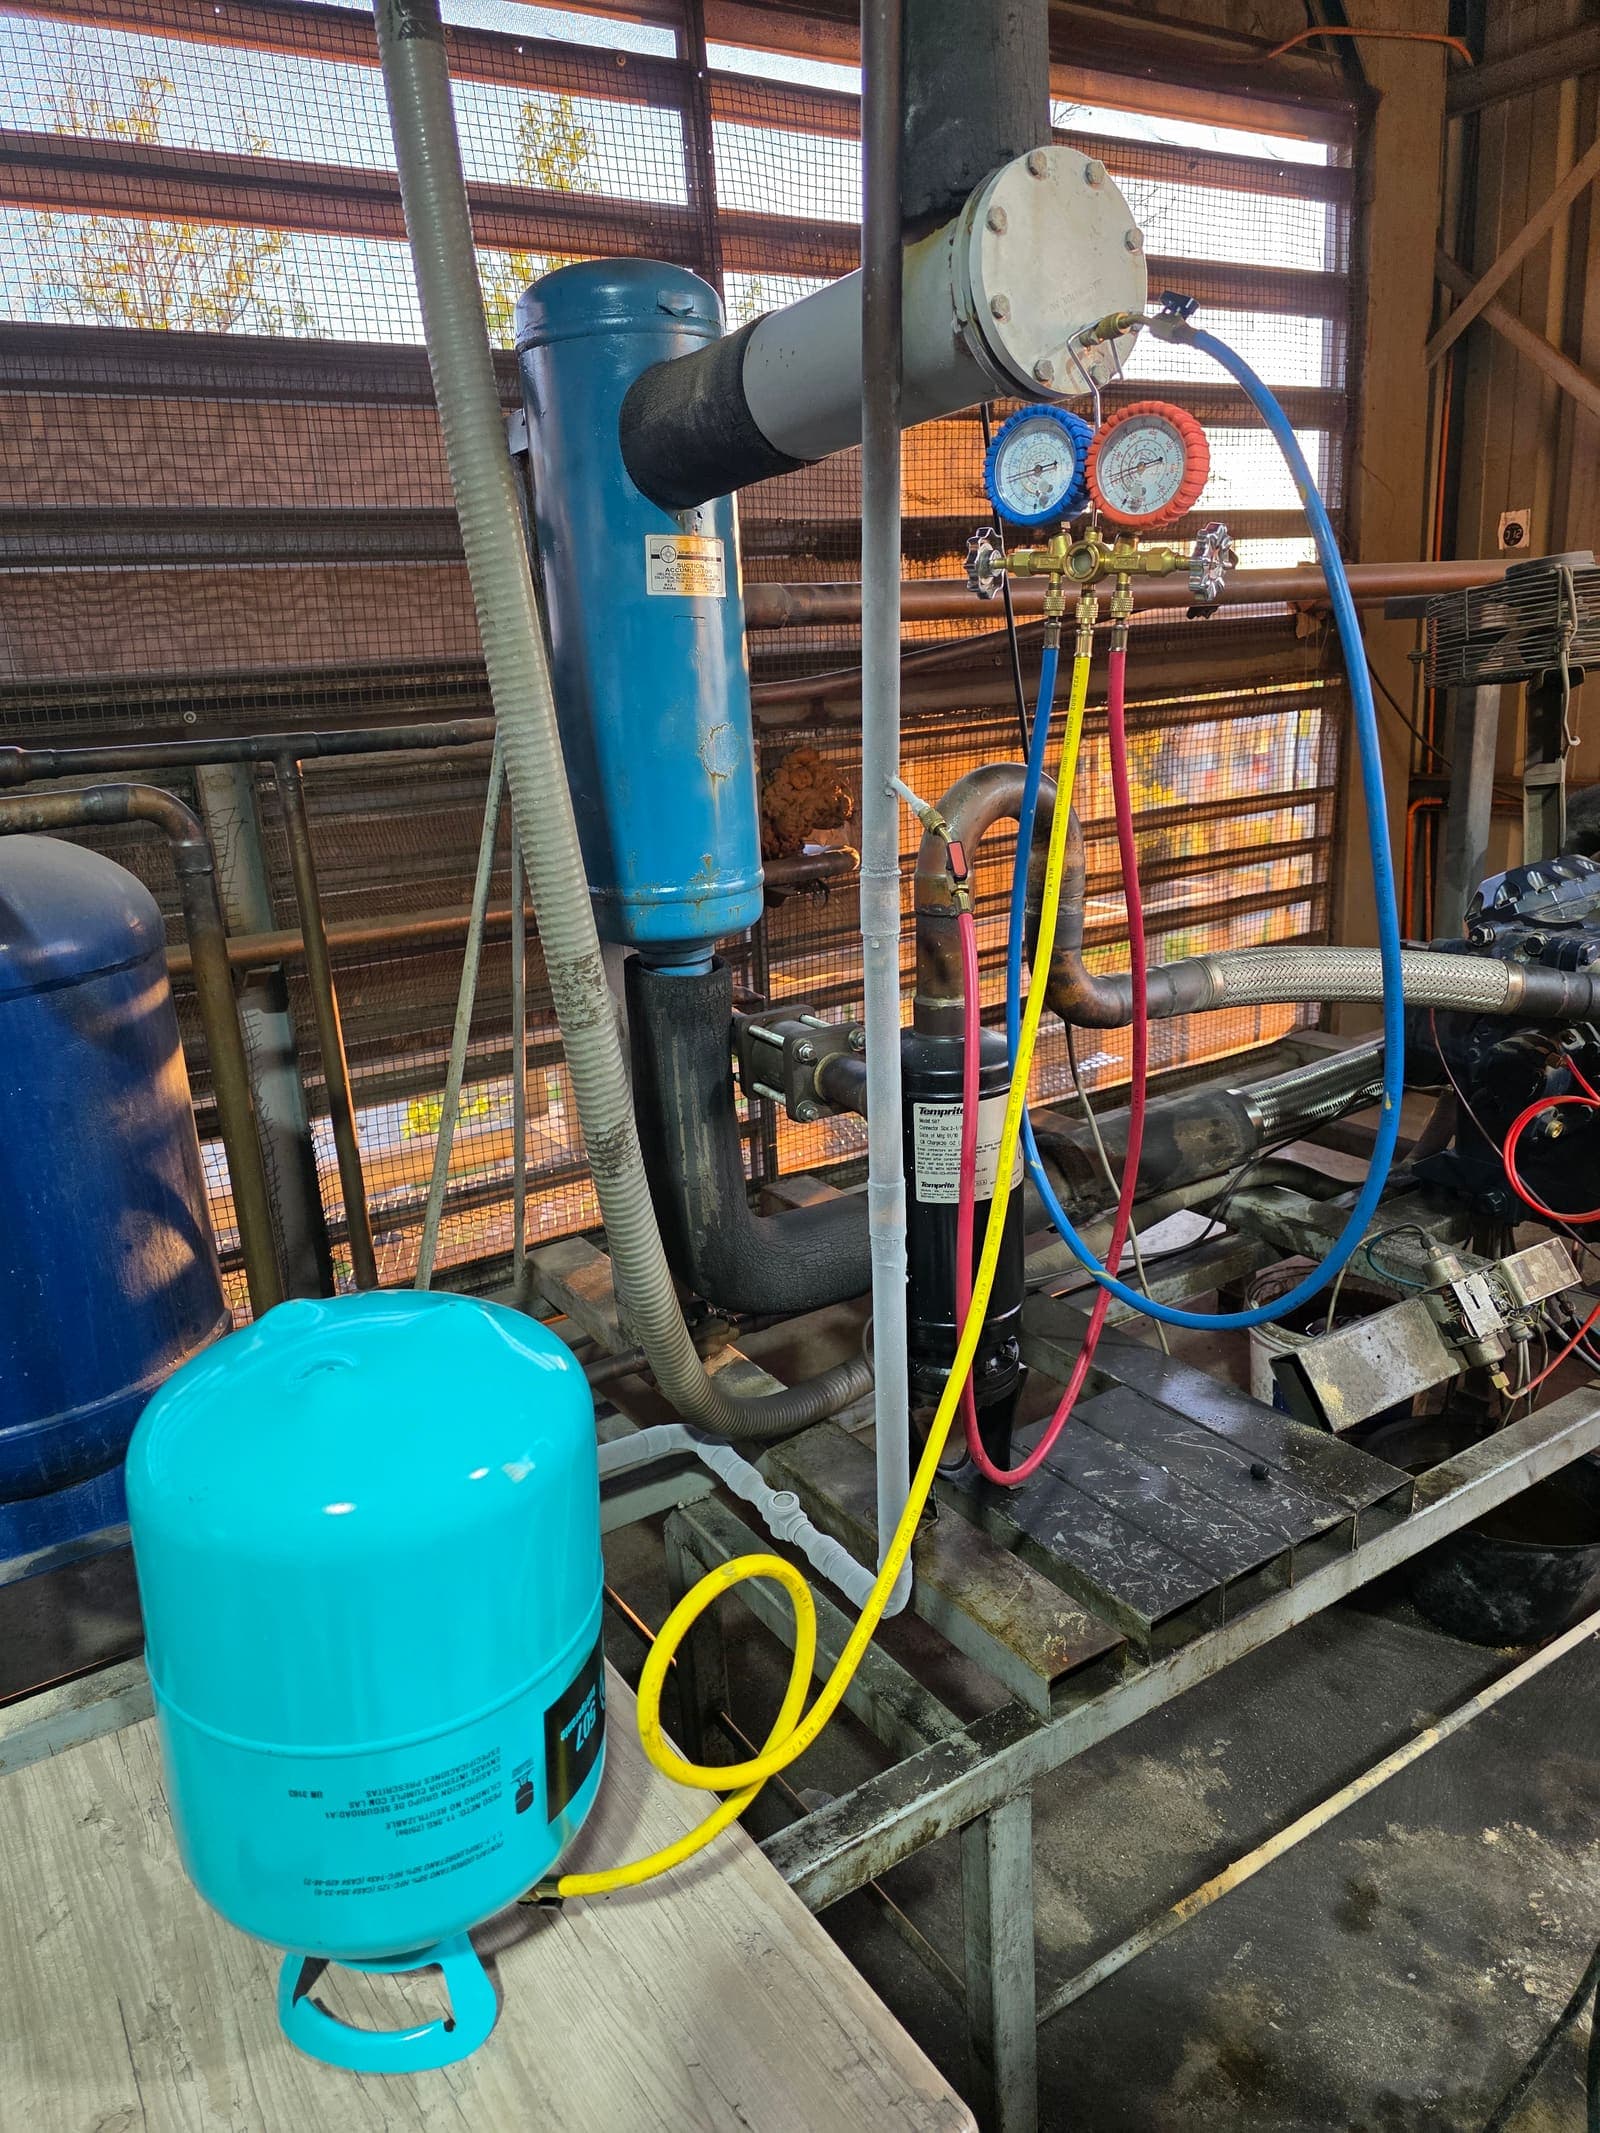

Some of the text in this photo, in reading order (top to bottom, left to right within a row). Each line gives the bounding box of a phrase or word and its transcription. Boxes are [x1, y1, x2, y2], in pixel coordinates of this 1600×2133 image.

[423, 1745, 501, 1785] ESPECIFICACIONES
[470, 1754, 502, 1776] ENVASE
[365, 1779, 423, 1799] PRESCRITAS
[429, 1771, 470, 1793] INTERIOR
[441, 1763, 502, 1797] CLASIFICACION
[368, 1797, 388, 1807] CON
[389, 1786, 427, 1804] CUMPLE
[407, 1790, 440, 1809] GRUPO
[464, 1780, 503, 1806] CILINDRO
[482, 1789, 503, 1807] PESO
[348, 1799, 367, 1810] LAS
